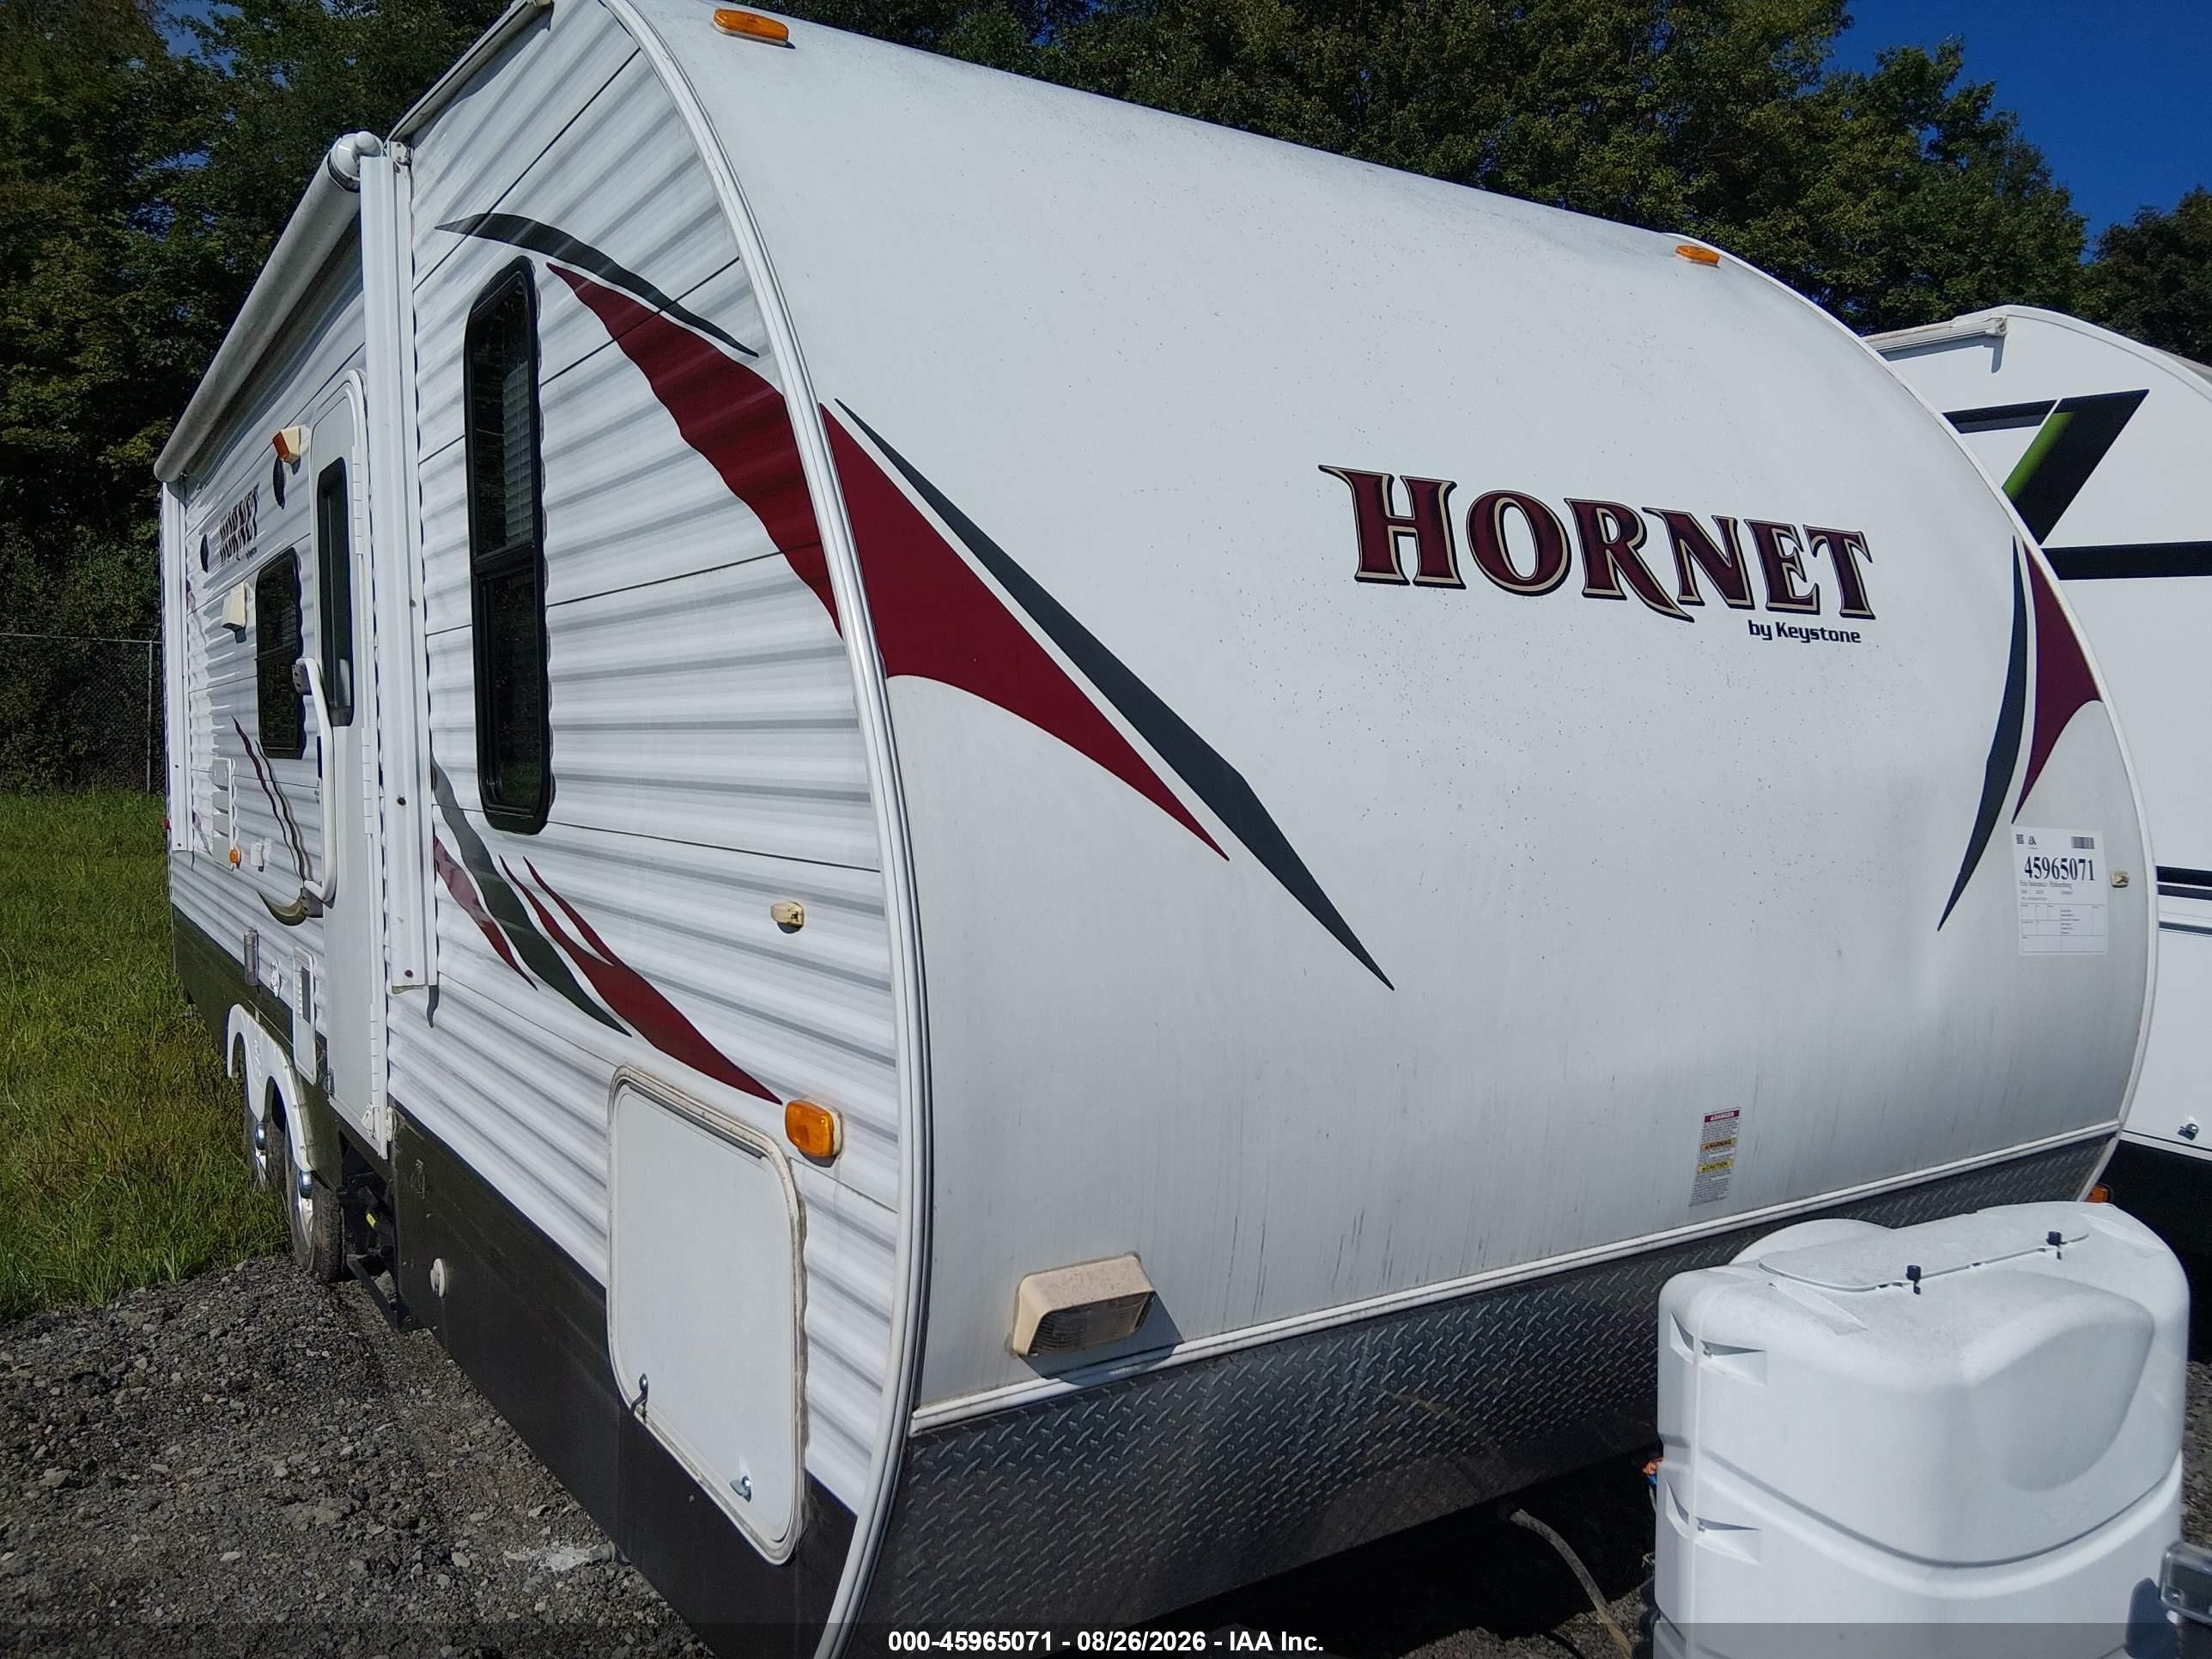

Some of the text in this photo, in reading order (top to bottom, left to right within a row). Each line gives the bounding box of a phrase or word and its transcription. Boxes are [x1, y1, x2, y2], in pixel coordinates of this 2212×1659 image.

[1318, 465, 1876, 623] HORNET
[1747, 619, 1863, 644] by Keystone
[2024, 855, 2095, 881] 45965071
